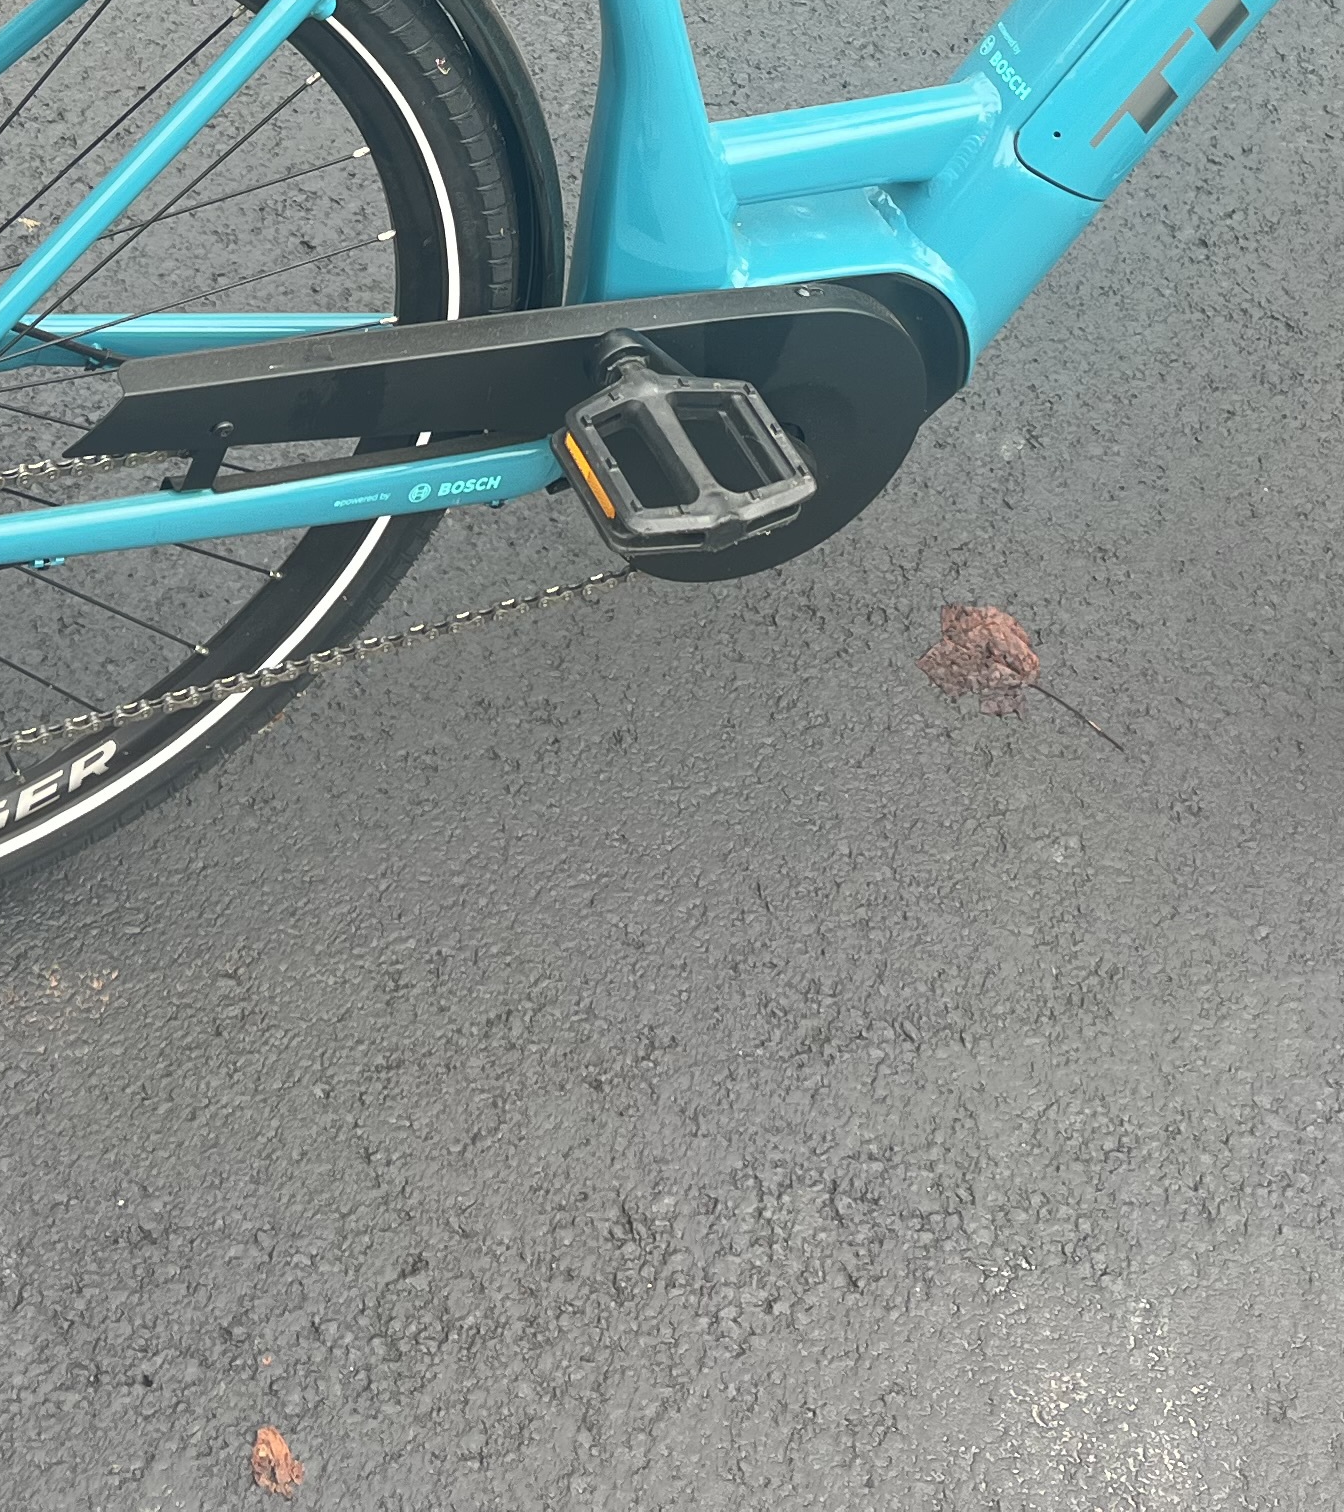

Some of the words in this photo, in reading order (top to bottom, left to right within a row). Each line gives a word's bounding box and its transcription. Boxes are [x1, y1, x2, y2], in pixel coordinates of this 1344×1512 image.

[989, 50, 1032, 101] BOSCH
[378, 492, 392, 501] by
[437, 475, 502, 497] BOSCH
